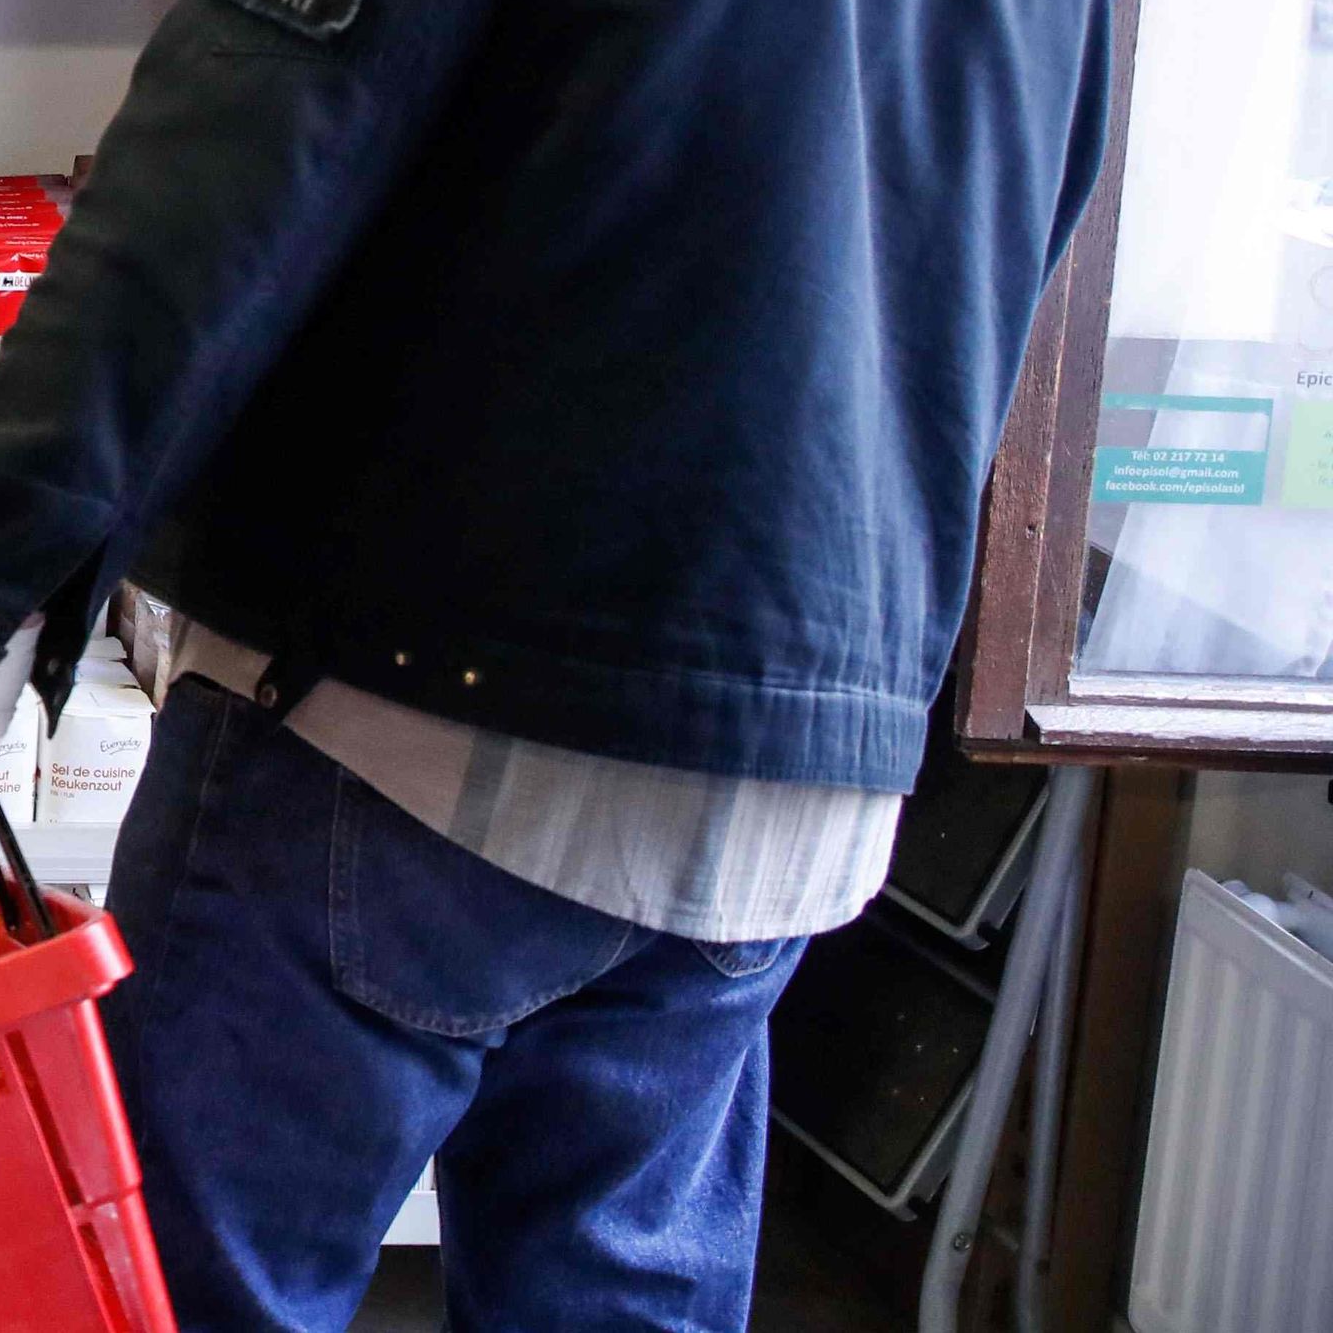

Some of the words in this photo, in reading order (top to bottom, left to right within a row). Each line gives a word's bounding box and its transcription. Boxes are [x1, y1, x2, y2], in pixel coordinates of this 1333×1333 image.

[1154, 452, 1167, 461] 02
[1171, 452, 1191, 461] 217
[100, 739, 141, 753] Everyday
[52, 764, 70, 776] Sel
[73, 766, 90, 777] de
[94, 767, 135, 778] cuisine
[51, 778, 122, 792] Keukenzout
